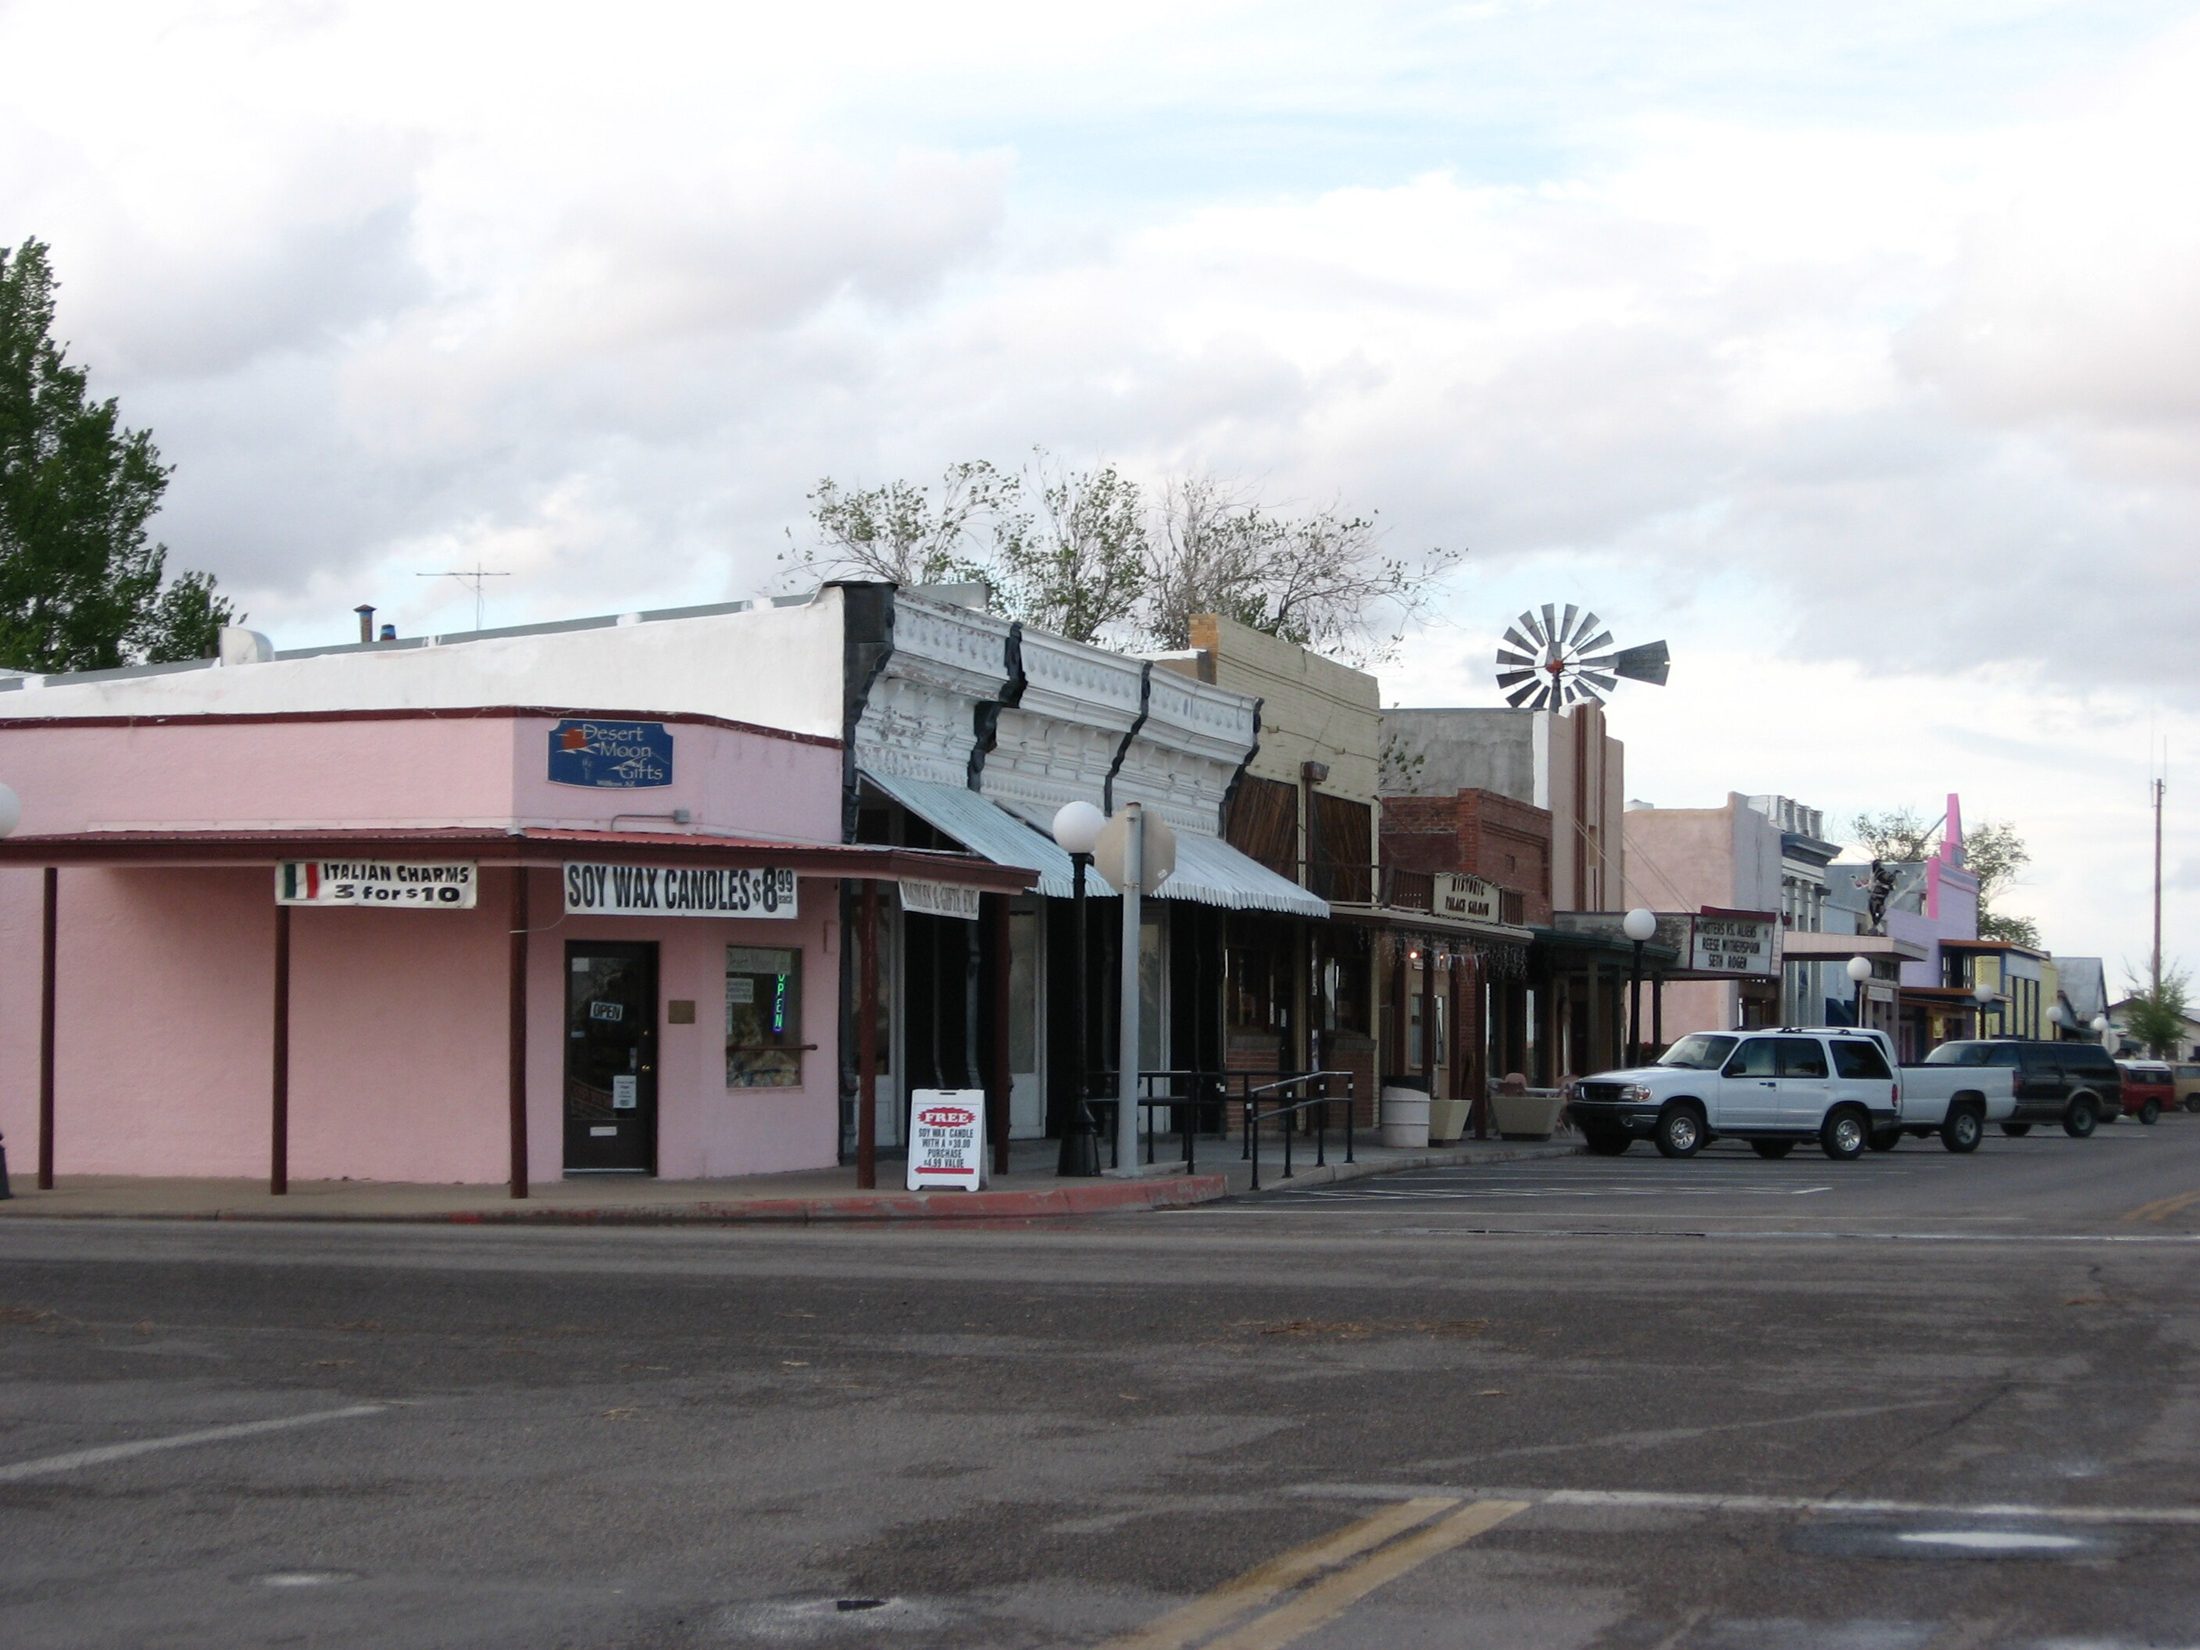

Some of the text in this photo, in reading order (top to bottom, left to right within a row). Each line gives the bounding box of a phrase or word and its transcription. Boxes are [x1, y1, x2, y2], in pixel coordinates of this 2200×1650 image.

[582, 724, 644, 741] Desert
[600, 741, 652, 758] Moon
[619, 758, 663, 780] Gifts
[324, 863, 469, 883] ITALIAN CHARMS
[334, 884, 354, 898] 3
[363, 886, 401, 901] for
[568, 864, 606, 907] SOY
[612, 865, 658, 908] WAX
[665, 868, 750, 911] CANDLES
[593, 1003, 621, 1020] OPEN
[924, 1112, 969, 1123] FREE
[919, 1128, 931, 1137] SOY
[949, 1128, 974, 1139] CANDLE
[922, 1138, 940, 1148] WITH
[940, 1138, 946, 1148] A
[927, 1148, 962, 1158] PURCHASE
[944, 1158, 965, 1169] VALUE
